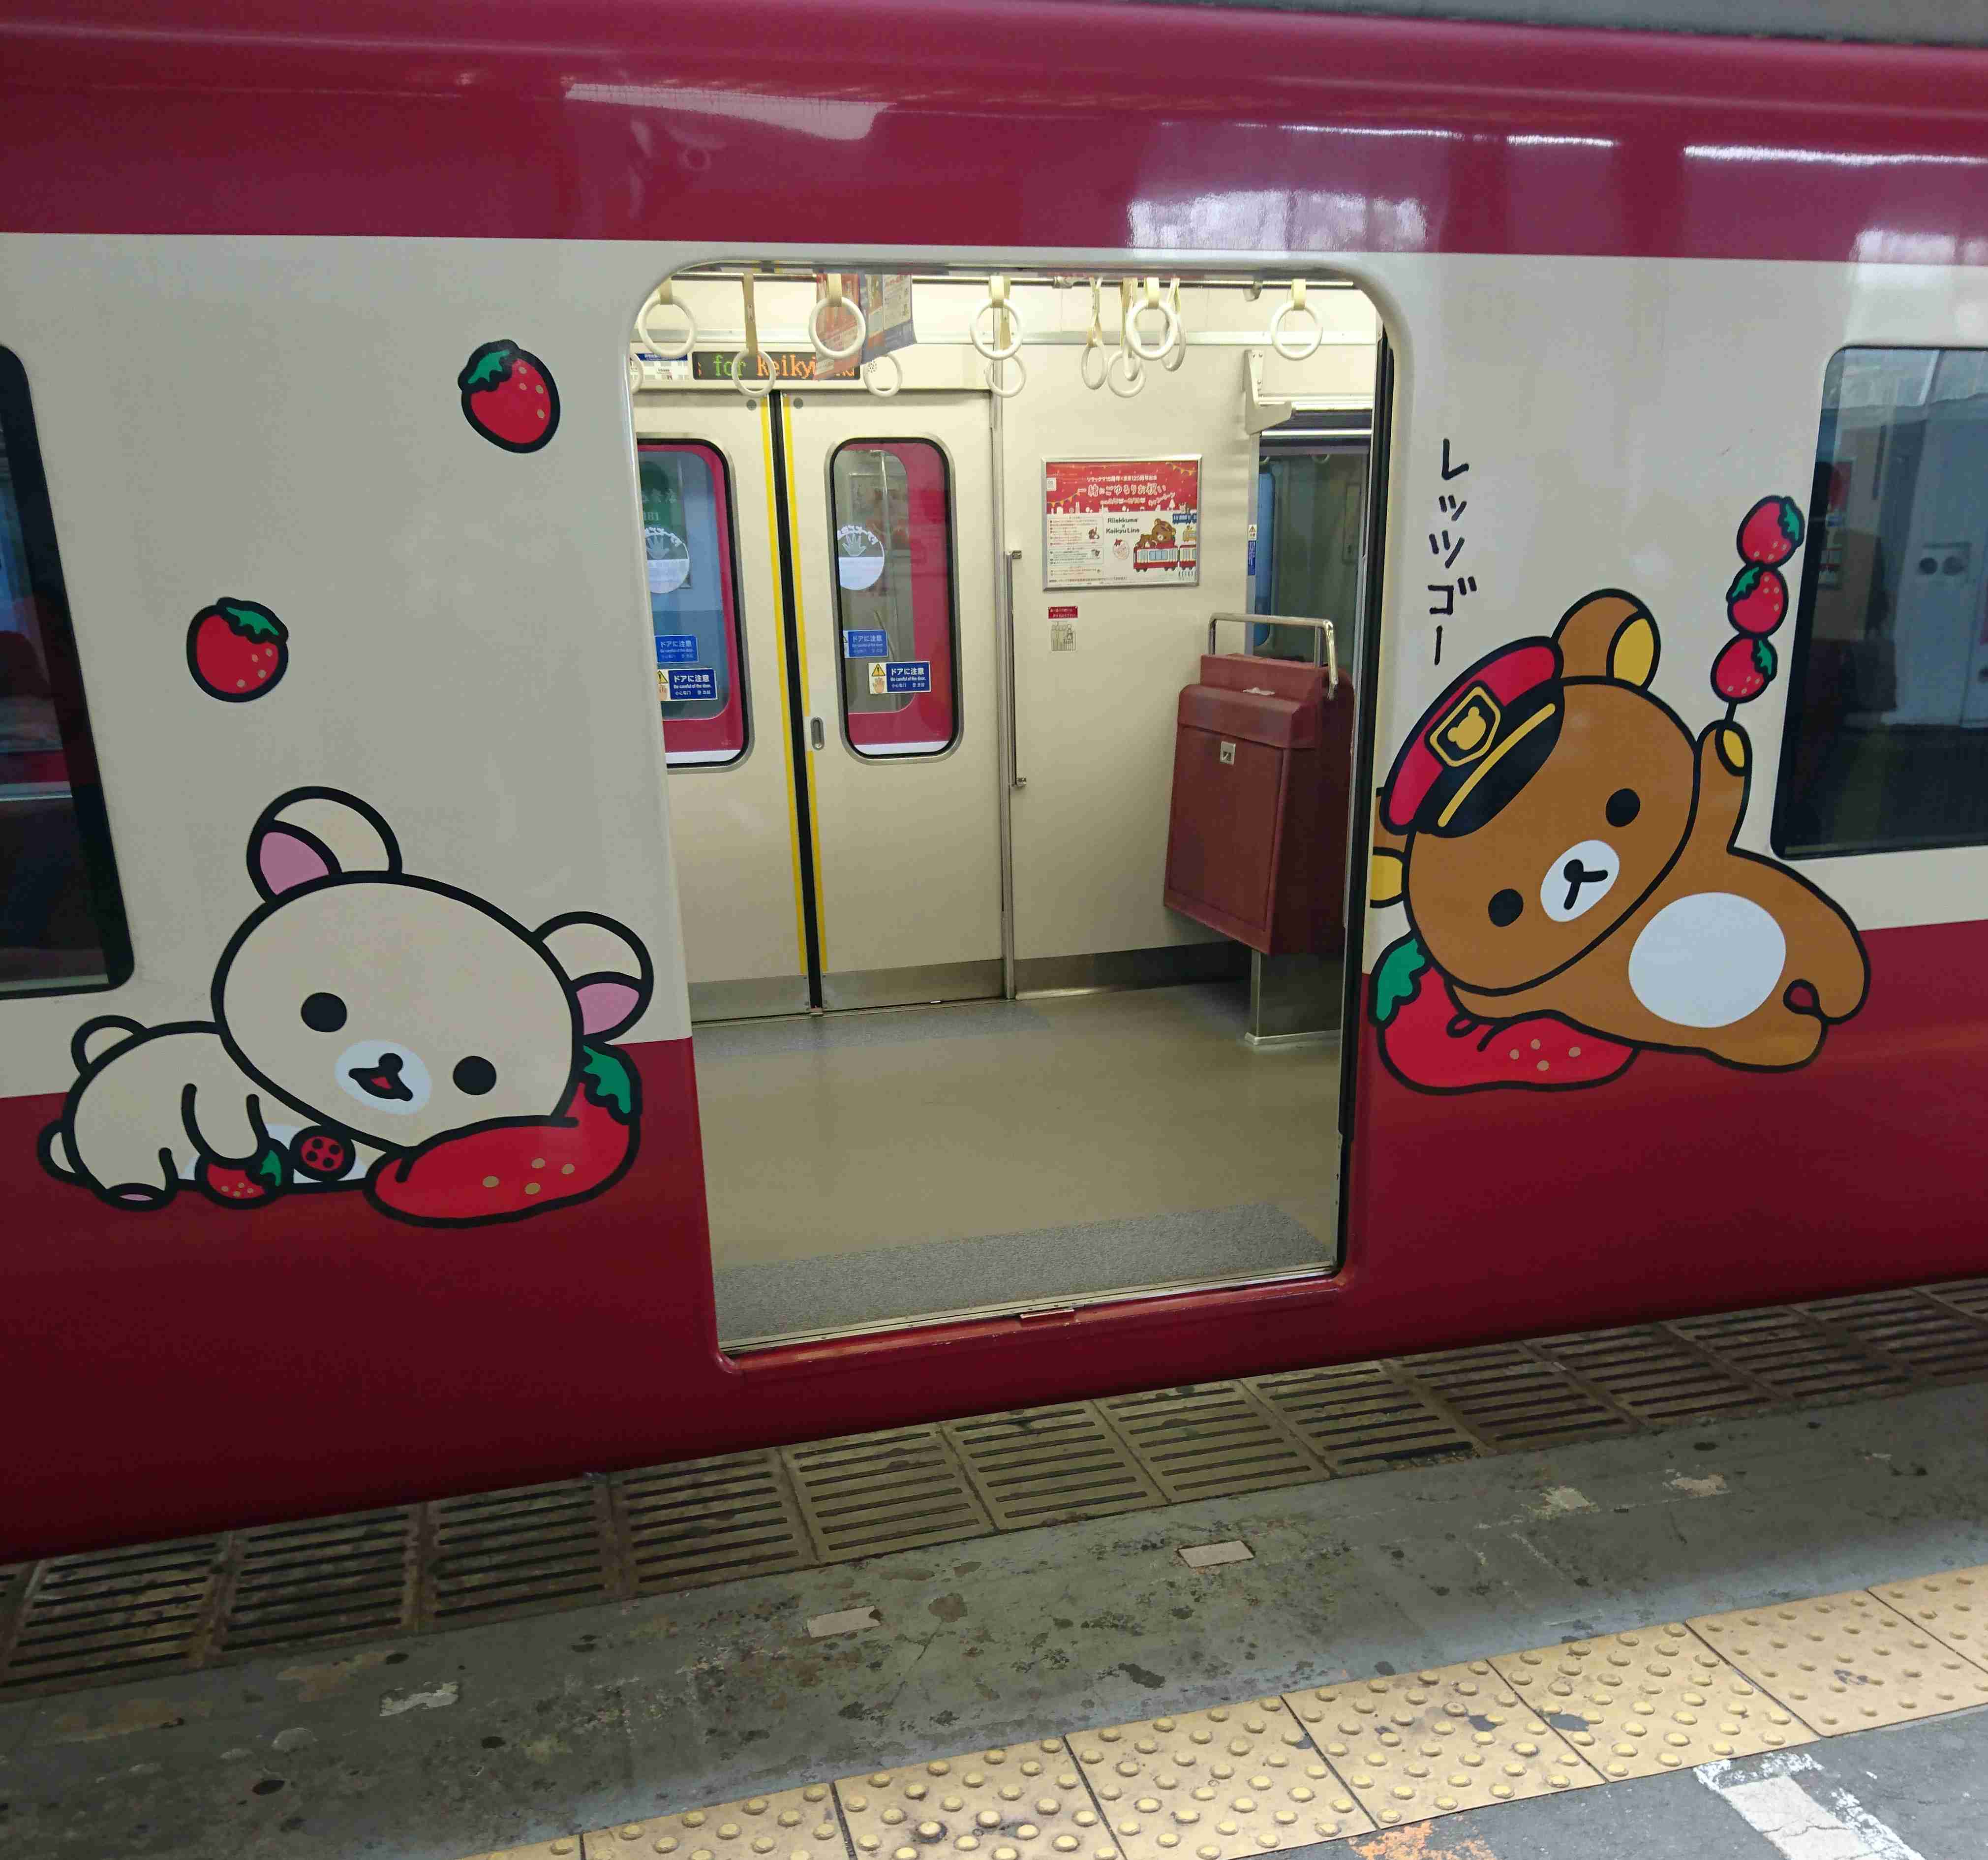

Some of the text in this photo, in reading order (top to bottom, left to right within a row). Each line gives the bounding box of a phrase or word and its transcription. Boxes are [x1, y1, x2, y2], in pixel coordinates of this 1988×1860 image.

[713, 354, 746, 377] for
[1428, 438, 1477, 665] レッツゴー
[891, 667, 924, 676] ドアに注意
